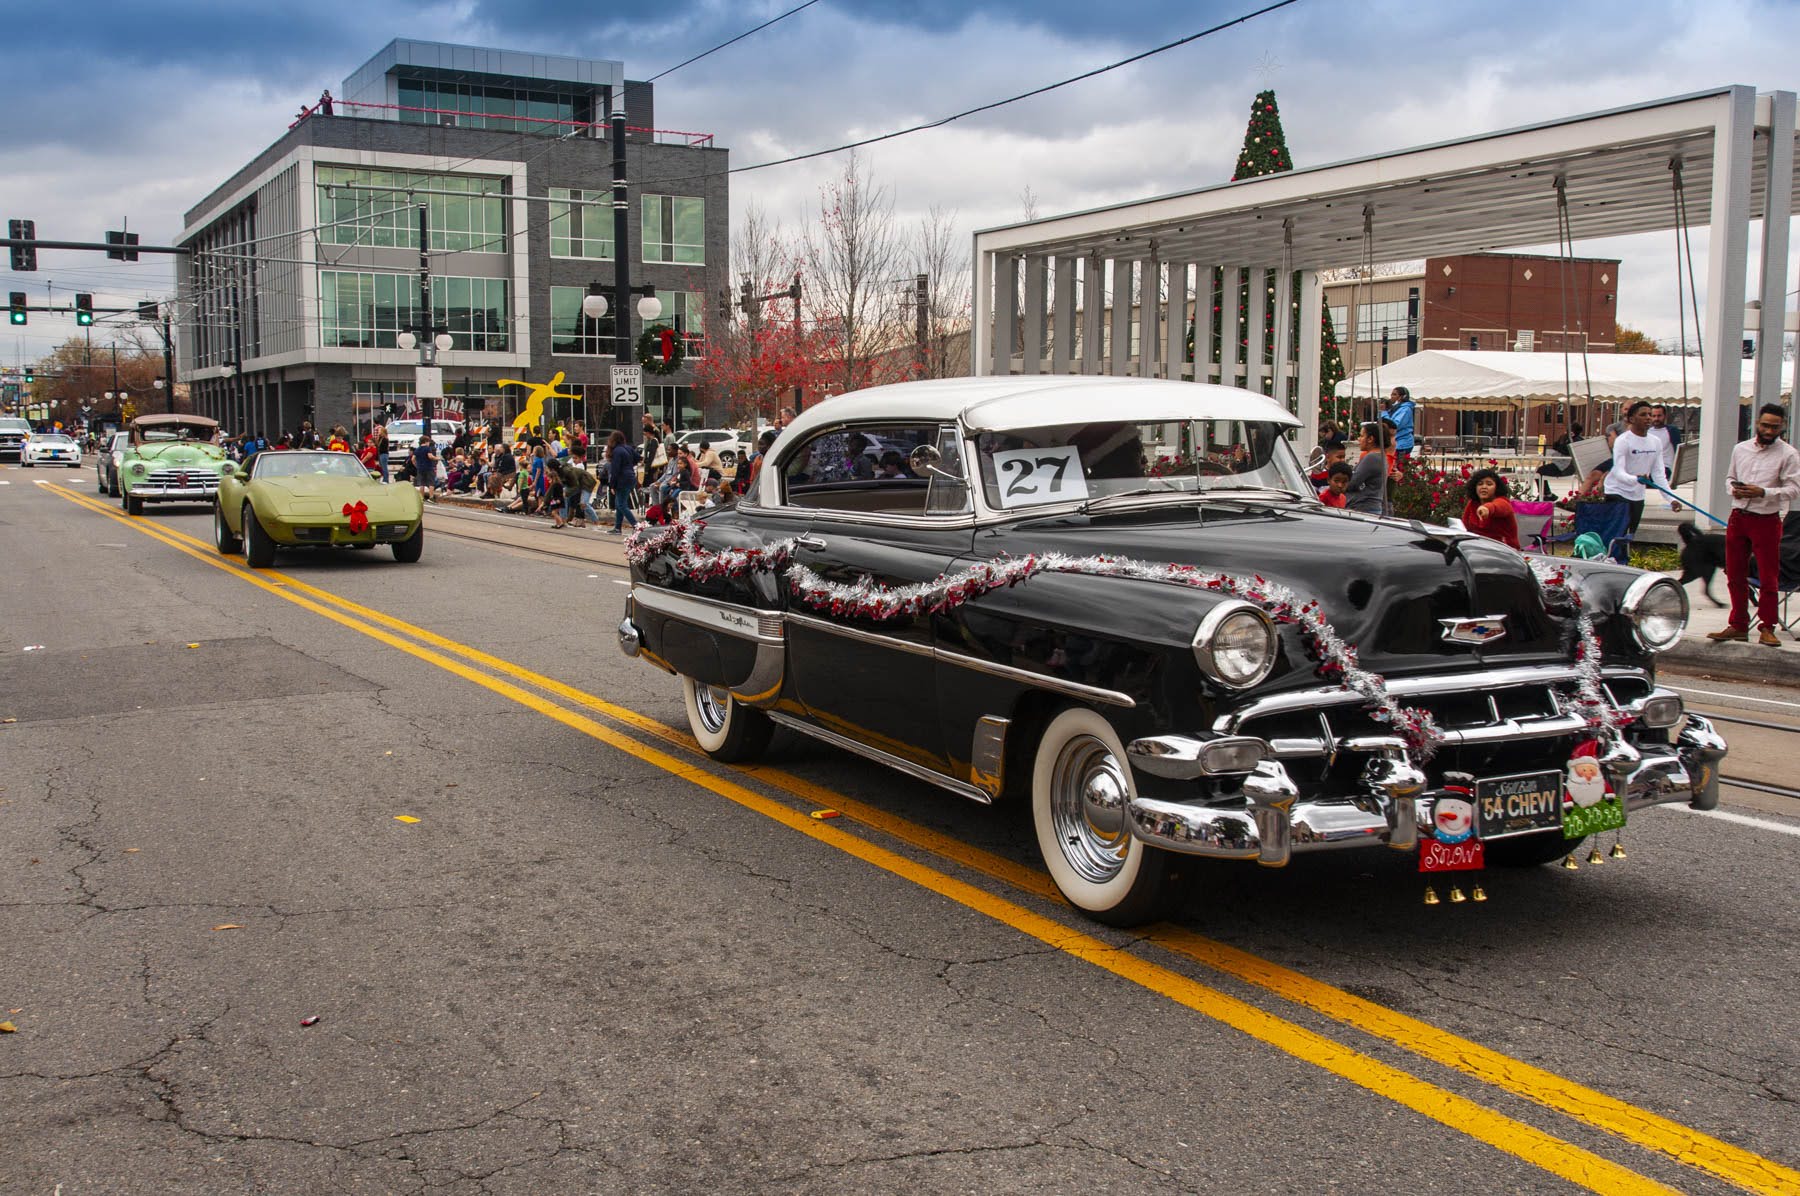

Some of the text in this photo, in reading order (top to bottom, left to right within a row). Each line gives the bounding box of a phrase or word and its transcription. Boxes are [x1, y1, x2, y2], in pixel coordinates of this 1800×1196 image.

[613, 368, 639, 376] SPEED
[616, 377, 637, 385] LIMIT
[615, 387, 639, 402] 25
[404, 398, 464, 414] WECOME
[1001, 455, 1071, 498] 27
[1507, 789, 1557, 817] CHEVY
